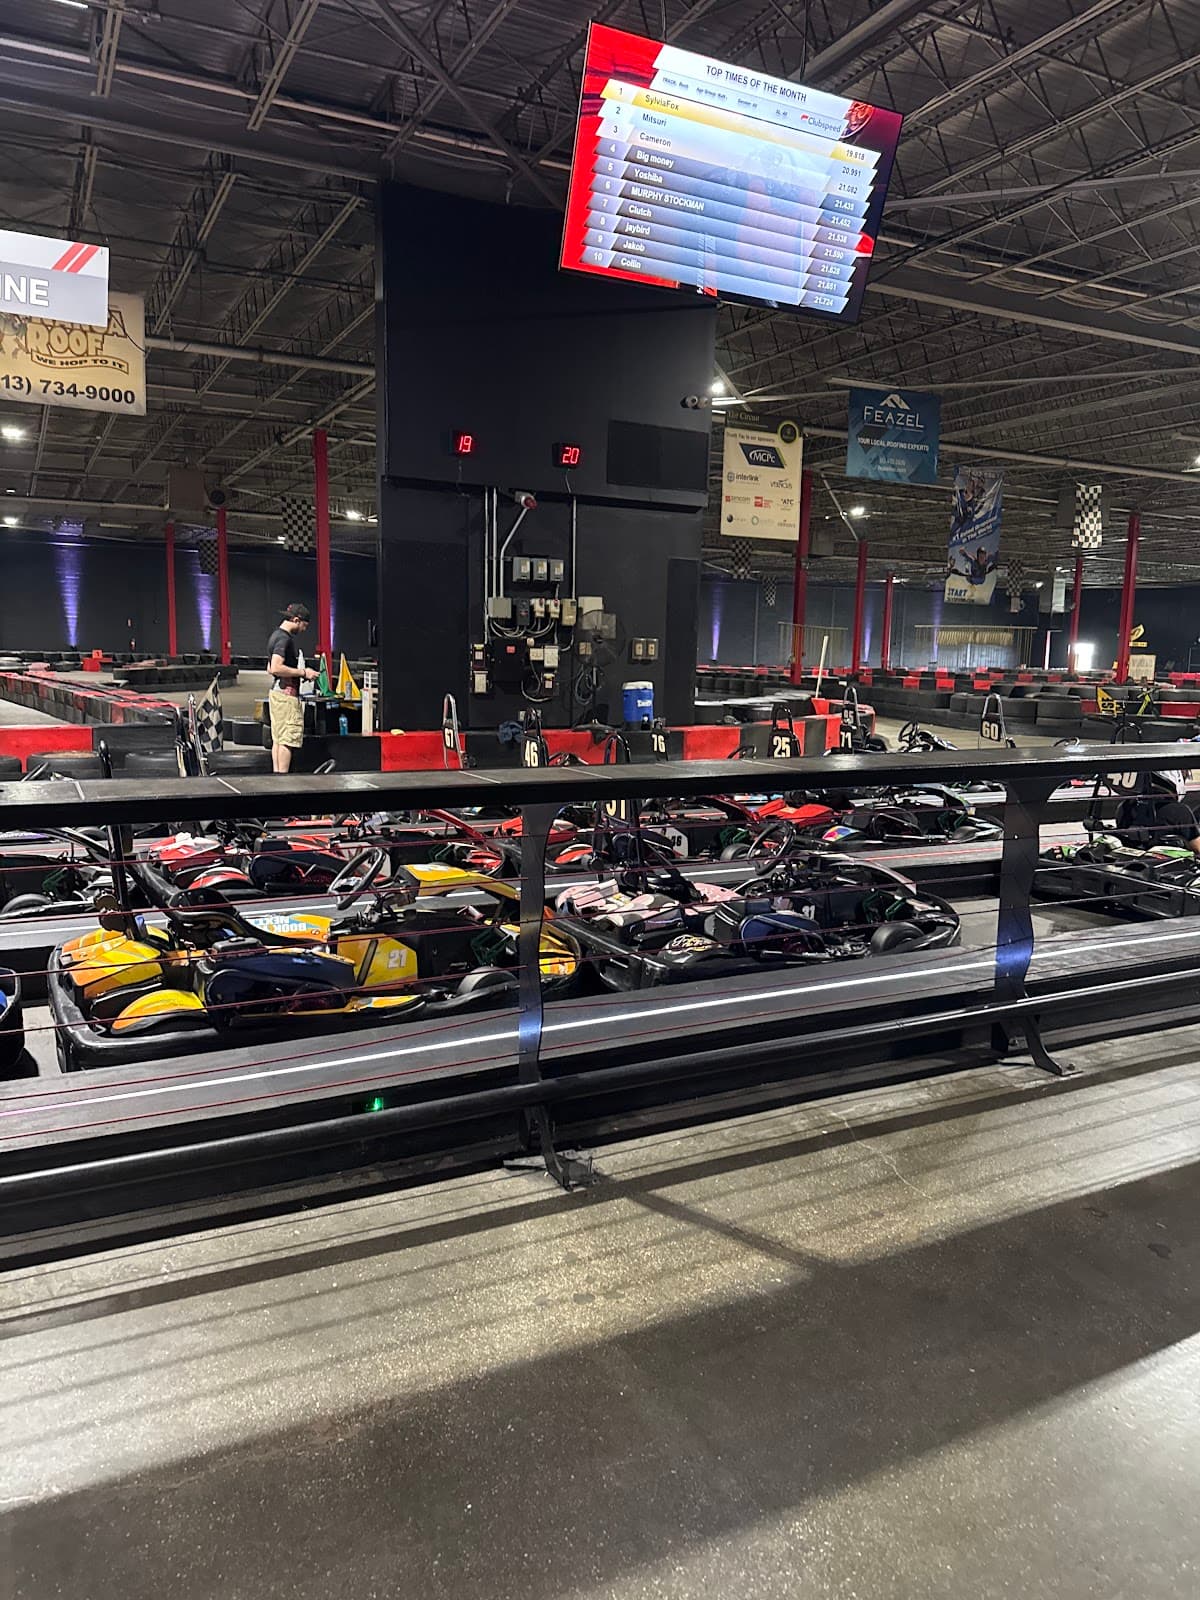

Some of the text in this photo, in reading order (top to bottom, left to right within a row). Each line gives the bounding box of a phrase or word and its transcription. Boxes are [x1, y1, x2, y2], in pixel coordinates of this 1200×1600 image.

[706, 65, 807, 102] TOP TIMES OF THE MONTH
[619, 87, 623, 95] 1
[645, 94, 679, 112] SylviaFox
[616, 106, 621, 115] 2
[642, 113, 667, 128] Mitsuri
[807, 116, 842, 134] Clubspeed
[613, 125, 618, 134] 3
[639, 132, 671, 147] Cameron
[610, 143, 616, 153] 4
[636, 150, 649, 162] Big
[650, 154, 674, 169] money
[607, 162, 613, 171] 5
[634, 168, 663, 183] Yoshiba
[605, 181, 611, 190] 6
[631, 186, 663, 202] MURPHY
[664, 194, 705, 211] STOCKMAN
[602, 199, 608, 208] 7
[629, 204, 652, 217] Clutch
[625, 222, 651, 236] jaybird
[597, 235, 603, 243] 9
[623, 241, 646, 252] Jakob
[594, 252, 603, 262] 10
[0, 272, 50, 308] NE
[36, 355, 56, 366] WE
[59, 359, 88, 367] HOP
[112, 361, 125, 370] IT
[40, 379, 136, 405] 734-9000
[863, 405, 924, 428] FEAZEL
[458, 435, 472, 453] 19
[857, 437, 929, 452] YOUR LOCAL ROOFING EXPERTS
[562, 446, 580, 464] 20
[735, 473, 759, 482] interlink
[947, 588, 968, 597] START
[982, 721, 999, 741] 60
[525, 740, 538, 767] 46
[773, 736, 791, 758] 25
[273, 922, 307, 933] BOOK
[388, 949, 407, 969] 21
